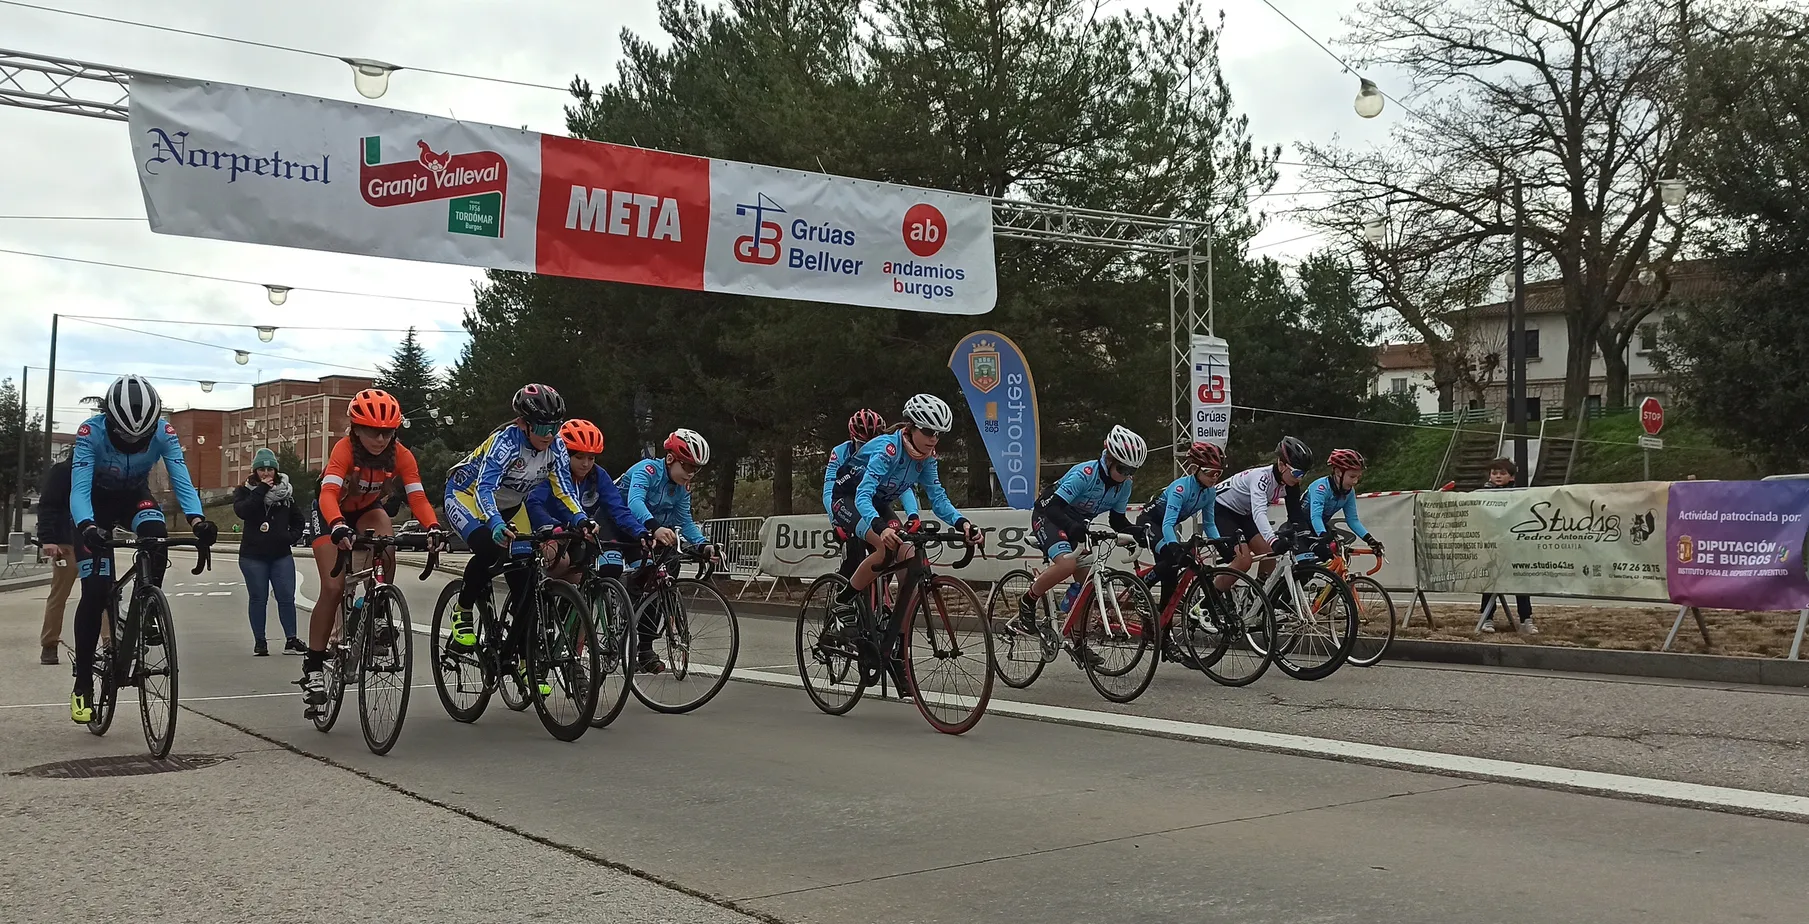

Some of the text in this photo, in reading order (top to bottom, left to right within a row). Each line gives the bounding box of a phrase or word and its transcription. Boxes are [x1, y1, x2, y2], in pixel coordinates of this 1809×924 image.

[146, 128, 331, 185] Norpetrol
[367, 162, 500, 199] Granja Valleval
[469, 204, 481, 212] 1956
[565, 185, 682, 242] META
[455, 211, 493, 224] TORDÓMAR
[465, 222, 482, 231] Burgos
[790, 218, 856, 247] Grúas
[910, 218, 940, 243] ab
[788, 249, 863, 277] Bellver
[883, 259, 966, 281] andamios
[893, 277, 954, 299] burgos
[1197, 410, 1227, 422] Grúas
[1643, 411, 1661, 421] STOP
[1197, 427, 1226, 437] Bellver
[446, 502, 462, 525] alter
[1510, 500, 1618, 533] Studio
[1678, 510, 1718, 521] Actividad
[1720, 511, 1778, 523] patrocinada
[1698, 540, 1776, 553] DIPUTACIÓN
[1613, 562, 1627, 571] 947
[1629, 563, 1640, 571] 26
[1697, 554, 1771, 566] DE BURGOS
[1705, 568, 1721, 576] PARA
[1721, 569, 1729, 577] EL
[1757, 568, 1789, 577] JUVENTUD
